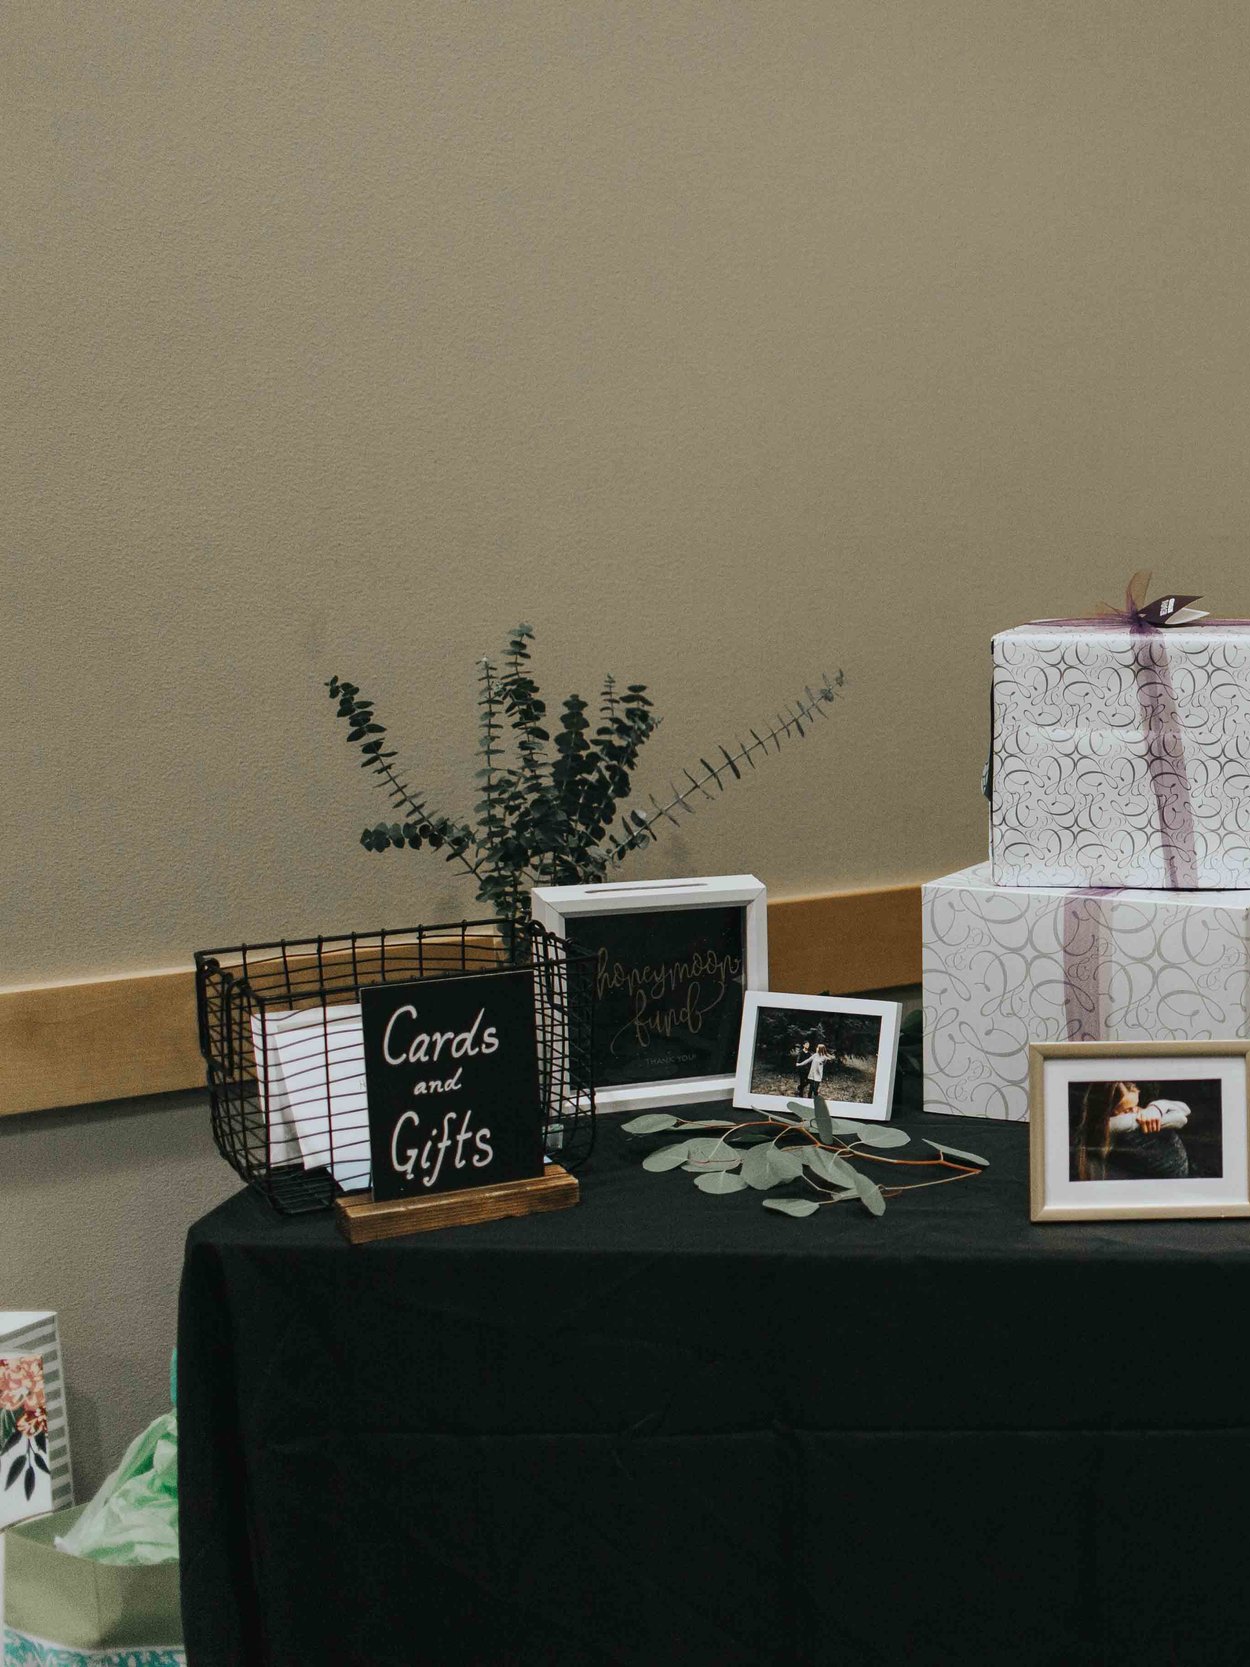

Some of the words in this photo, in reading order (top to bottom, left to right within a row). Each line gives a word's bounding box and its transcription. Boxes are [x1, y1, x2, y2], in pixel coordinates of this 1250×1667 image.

[596, 947, 742, 1000] honeymoon
[382, 1004, 500, 1065] Cards
[610, 981, 725, 1056] fund
[413, 1066, 463, 1095] and
[391, 1109, 494, 1187] Gifts
